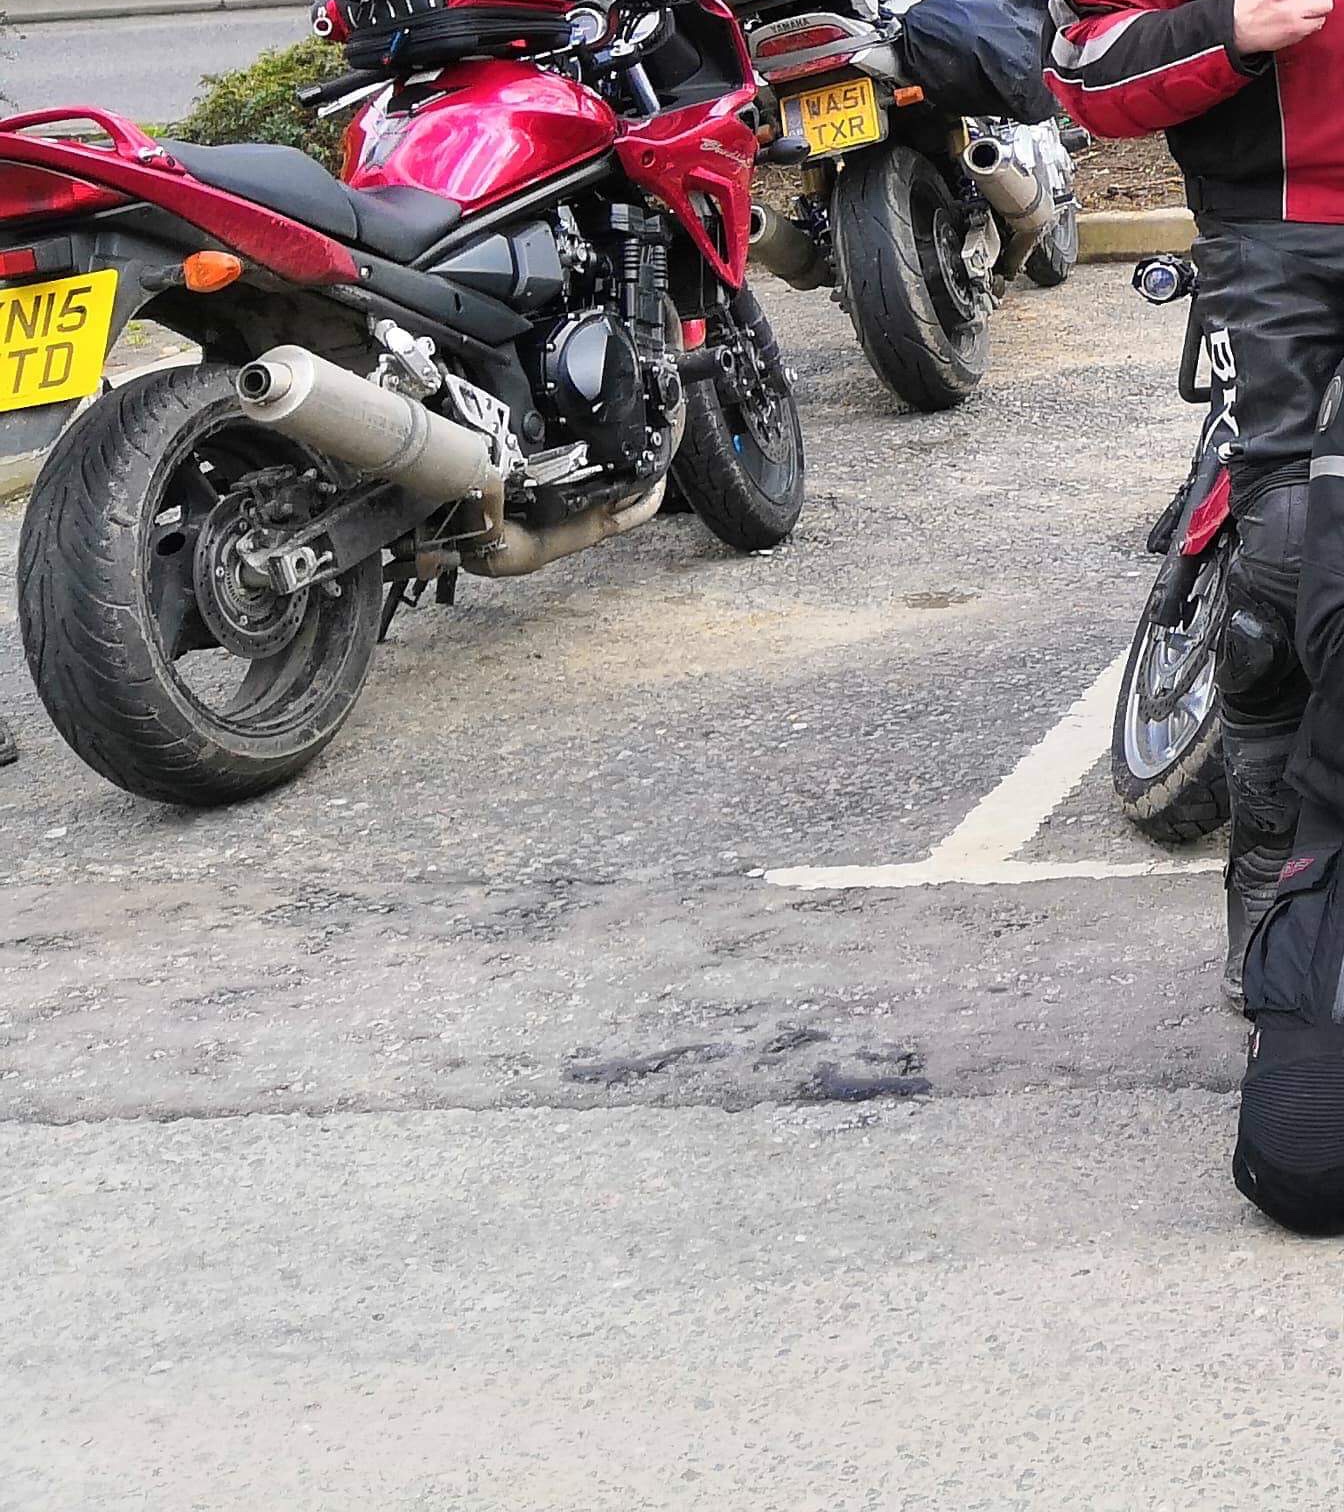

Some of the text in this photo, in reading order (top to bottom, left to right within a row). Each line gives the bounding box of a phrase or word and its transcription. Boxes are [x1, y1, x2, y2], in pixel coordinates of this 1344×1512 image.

[769, 17, 811, 34] YAMAHA
[812, 115, 865, 146] TXR
[0, 286, 92, 344] N15
[0, 342, 74, 394] TD
